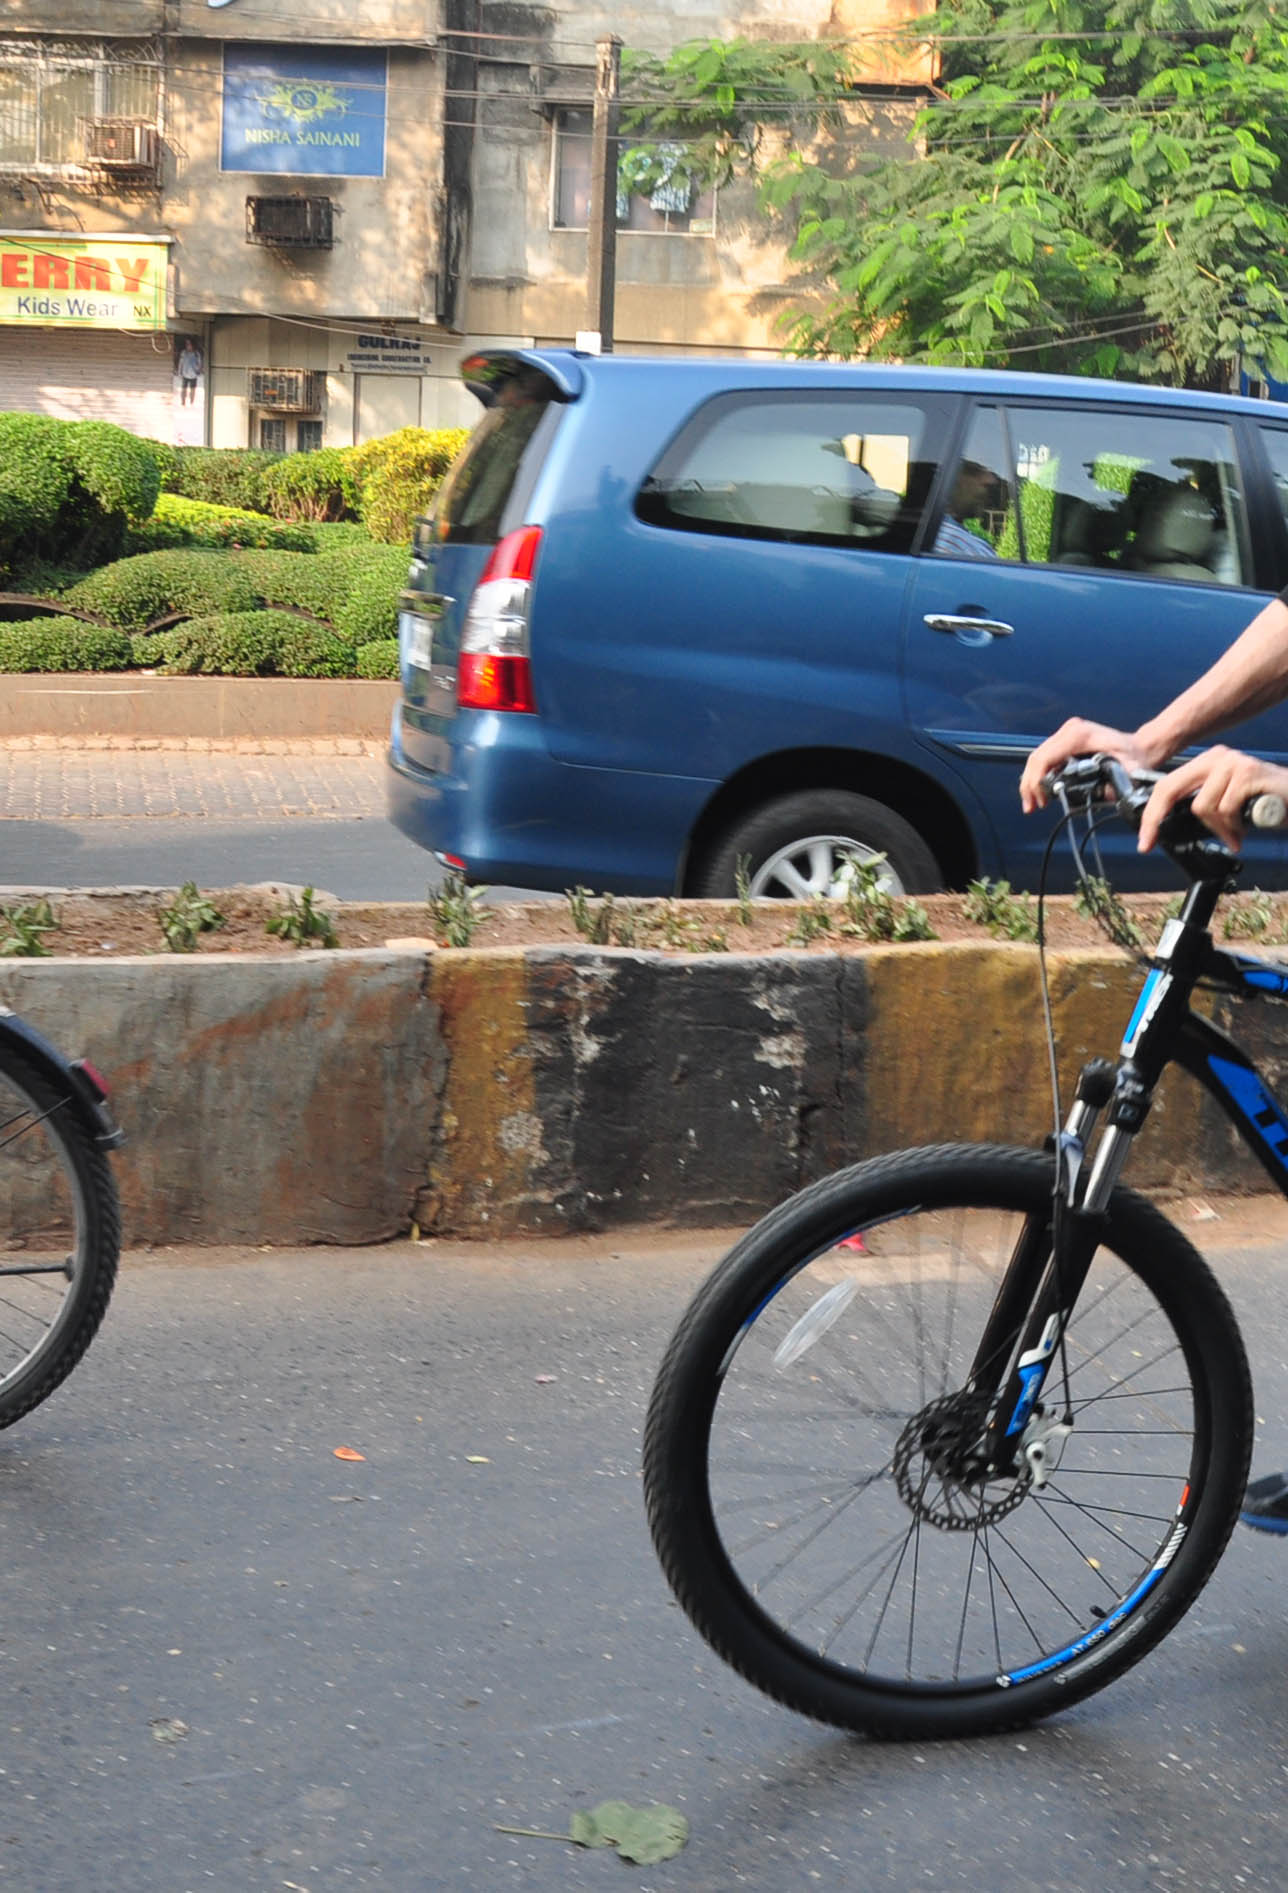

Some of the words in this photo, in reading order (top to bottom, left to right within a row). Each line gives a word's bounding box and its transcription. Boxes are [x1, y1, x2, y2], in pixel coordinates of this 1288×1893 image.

[244, 128, 291, 145] NISHA
[295, 131, 361, 148] SAINANI
[18, 296, 61, 316] Kids
[67, 298, 118, 317] Wear
